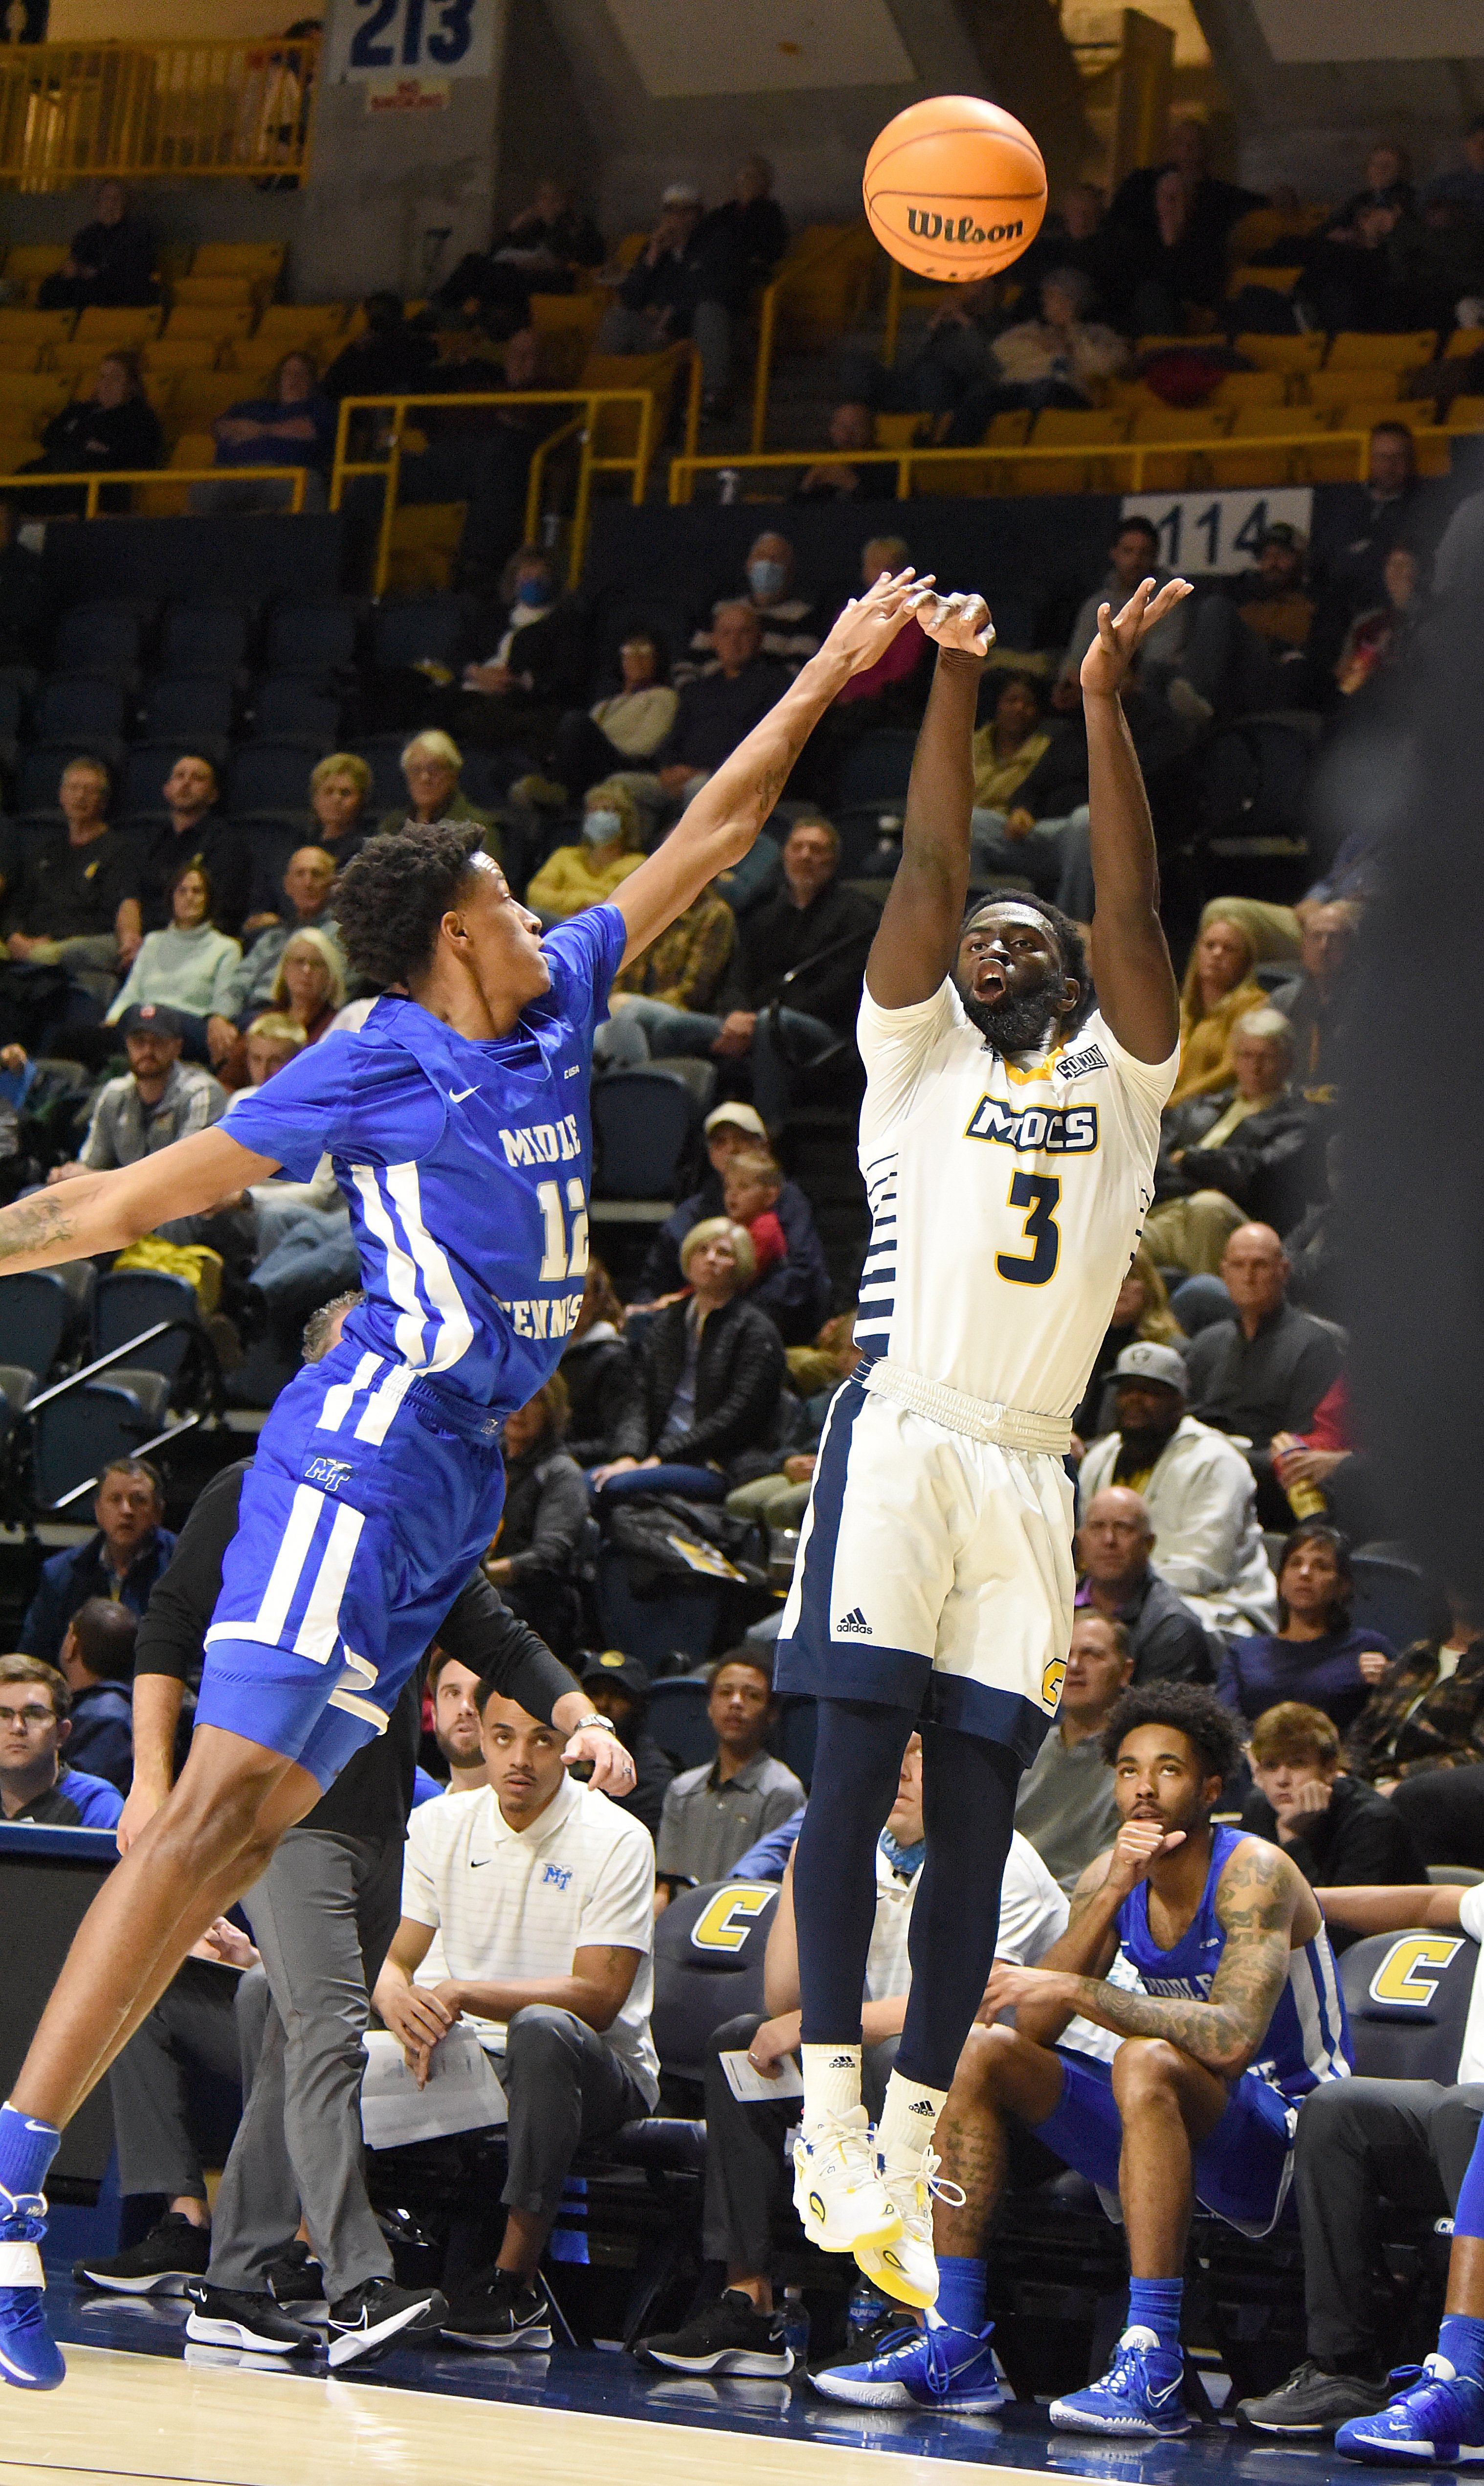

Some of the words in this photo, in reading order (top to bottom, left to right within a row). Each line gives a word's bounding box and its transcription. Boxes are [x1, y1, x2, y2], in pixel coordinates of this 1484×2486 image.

[350, 0, 473, 66] 213
[907, 206, 1023, 244] Wilson
[1157, 498, 1269, 567] 114
[969, 1099, 1096, 1149] MOCS
[537, 1177, 589, 1281] 12
[994, 1167, 1062, 1288] 3
[304, 1457, 351, 1492] MT
[836, 1622, 872, 1634] adidas
[542, 1864, 573, 1891] MT
[691, 1885, 778, 1952] C
[1369, 1935, 1466, 2006] C
[908, 2105, 936, 2117] adidas
